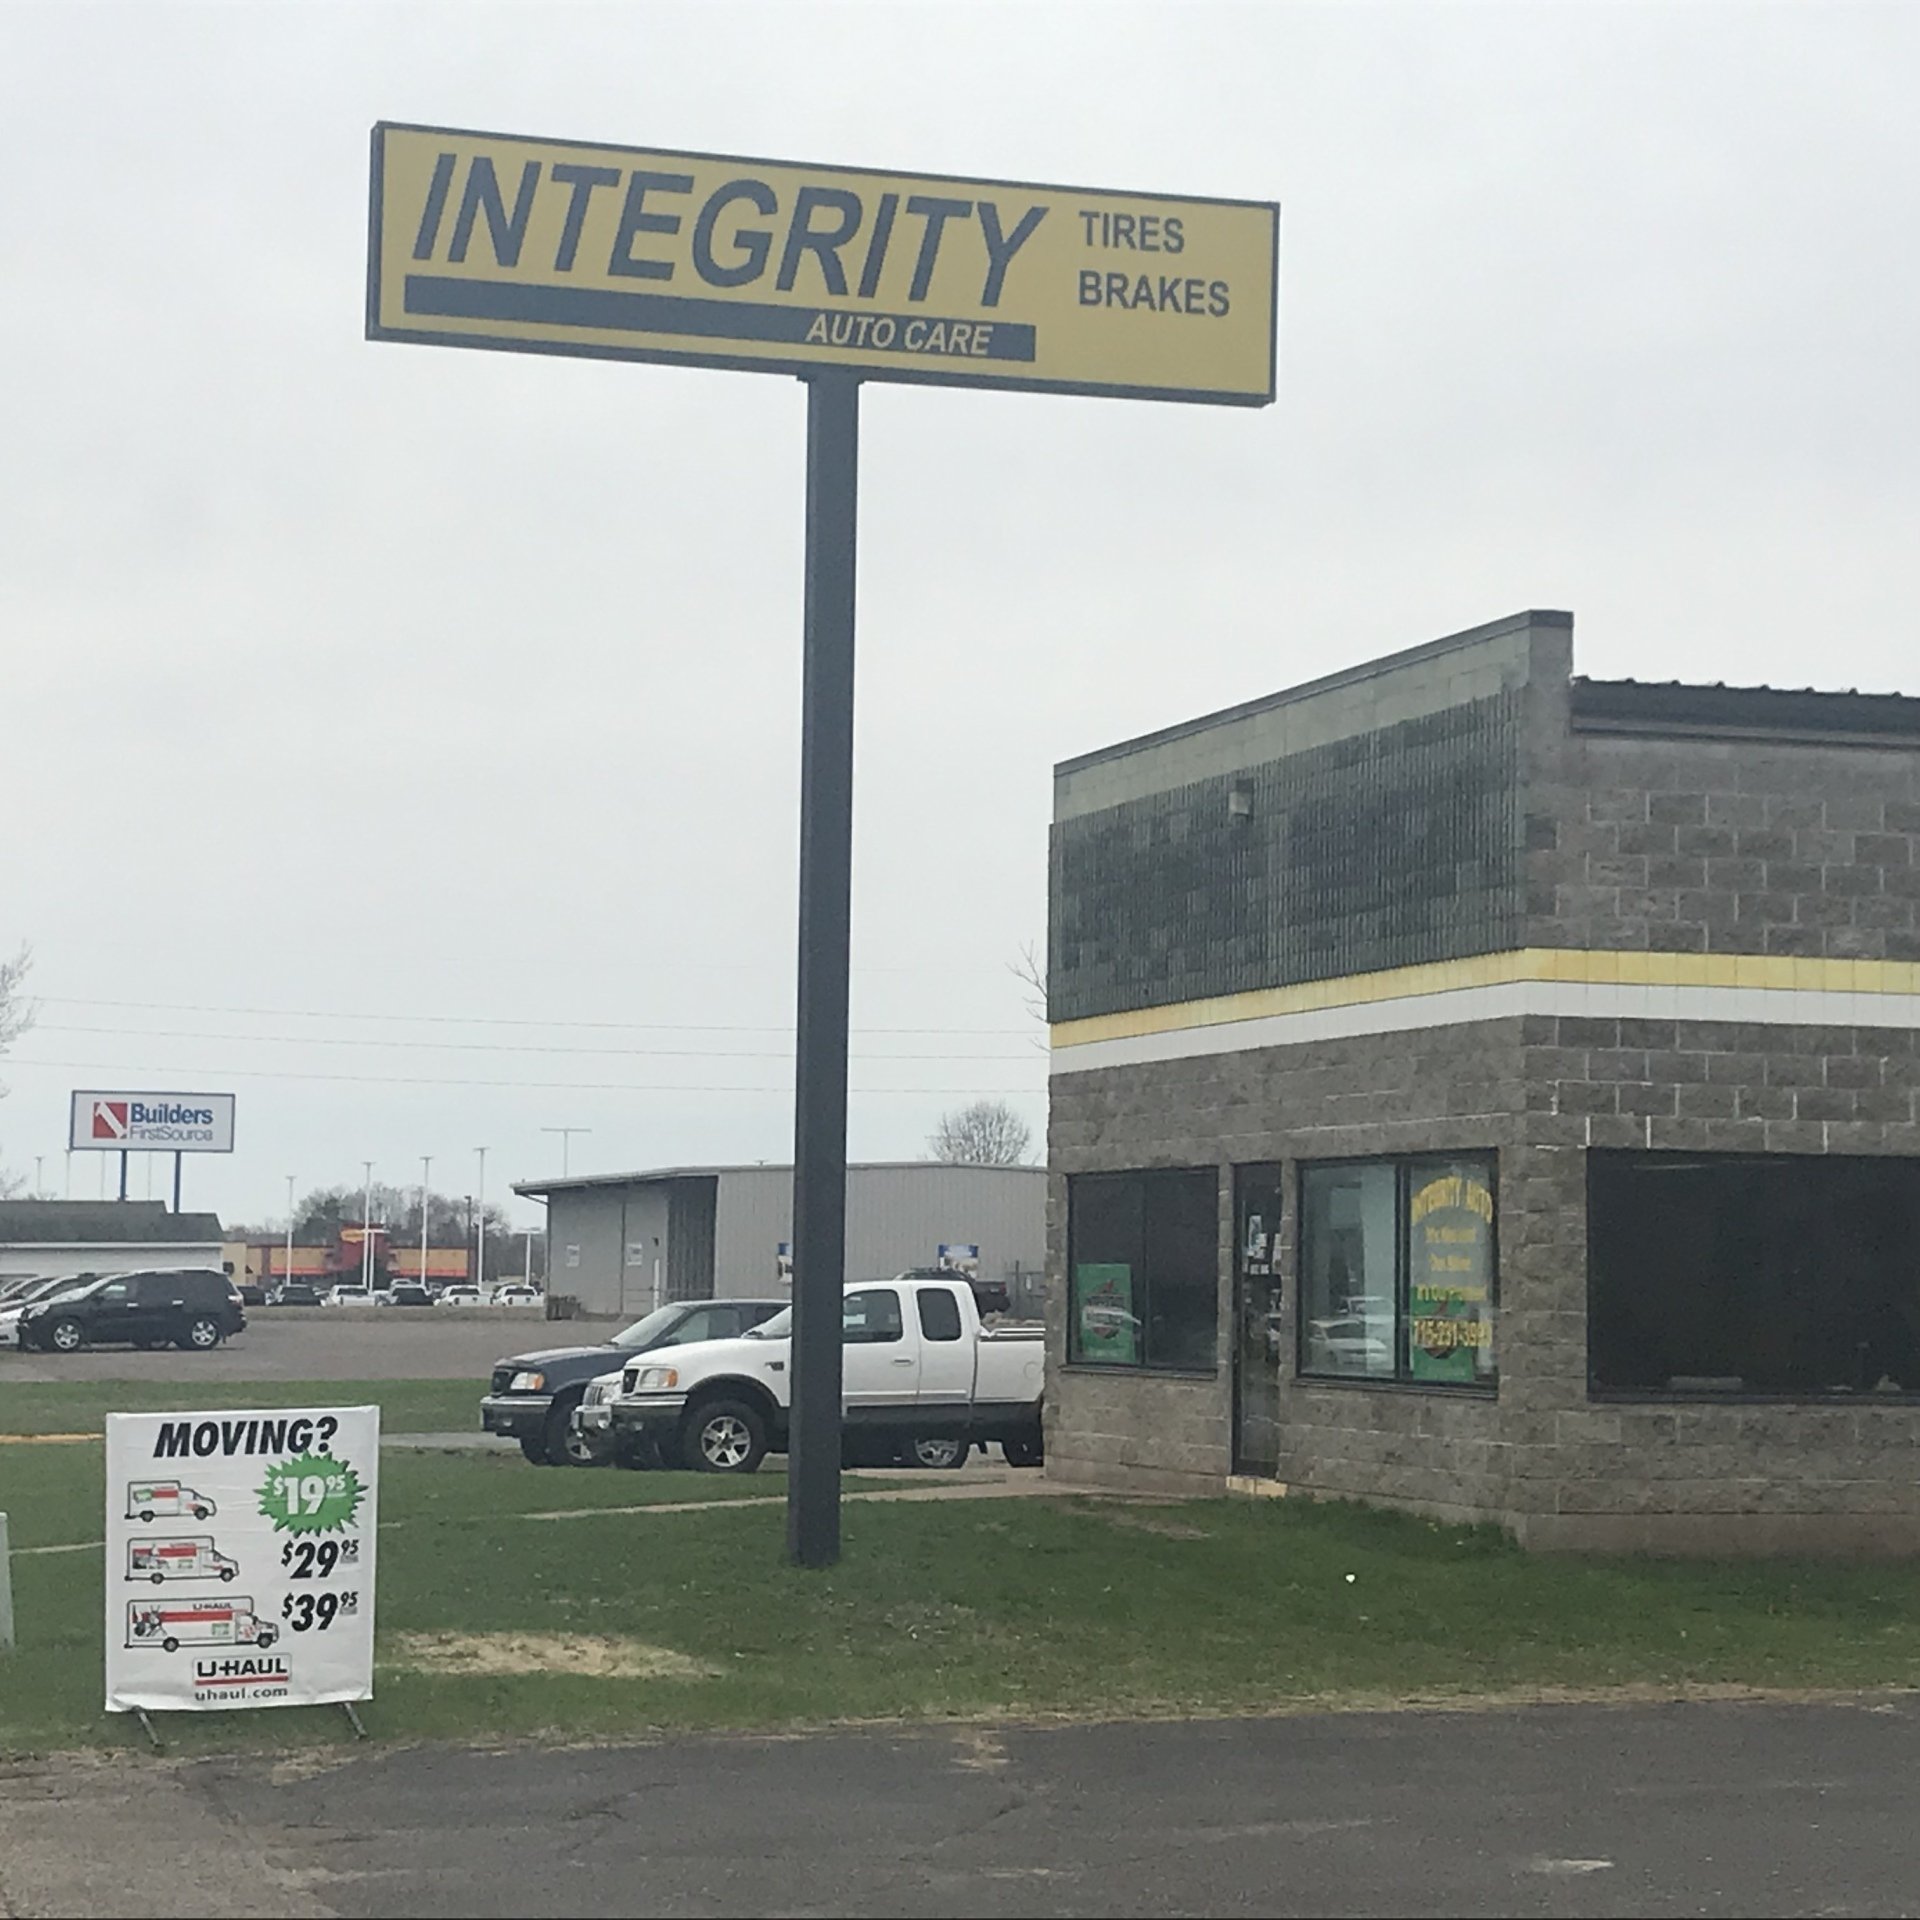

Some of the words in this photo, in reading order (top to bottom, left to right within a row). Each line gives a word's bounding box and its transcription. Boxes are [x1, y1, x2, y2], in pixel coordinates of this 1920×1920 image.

[413, 153, 1049, 307] INTEGRITY
[1078, 211, 1185, 255] TIRES
[1078, 271, 1230, 319] BRAKES
[806, 312, 897, 350] AUTO
[903, 319, 993, 357] CARE
[129, 1125, 213, 1142] FirstSource
[131, 1103, 213, 1125] Builders
[153, 1416, 338, 1458] MOVING?
[197, 1658, 288, 1677] U-HAUL
[194, 1687, 288, 1701] uhaul.com
